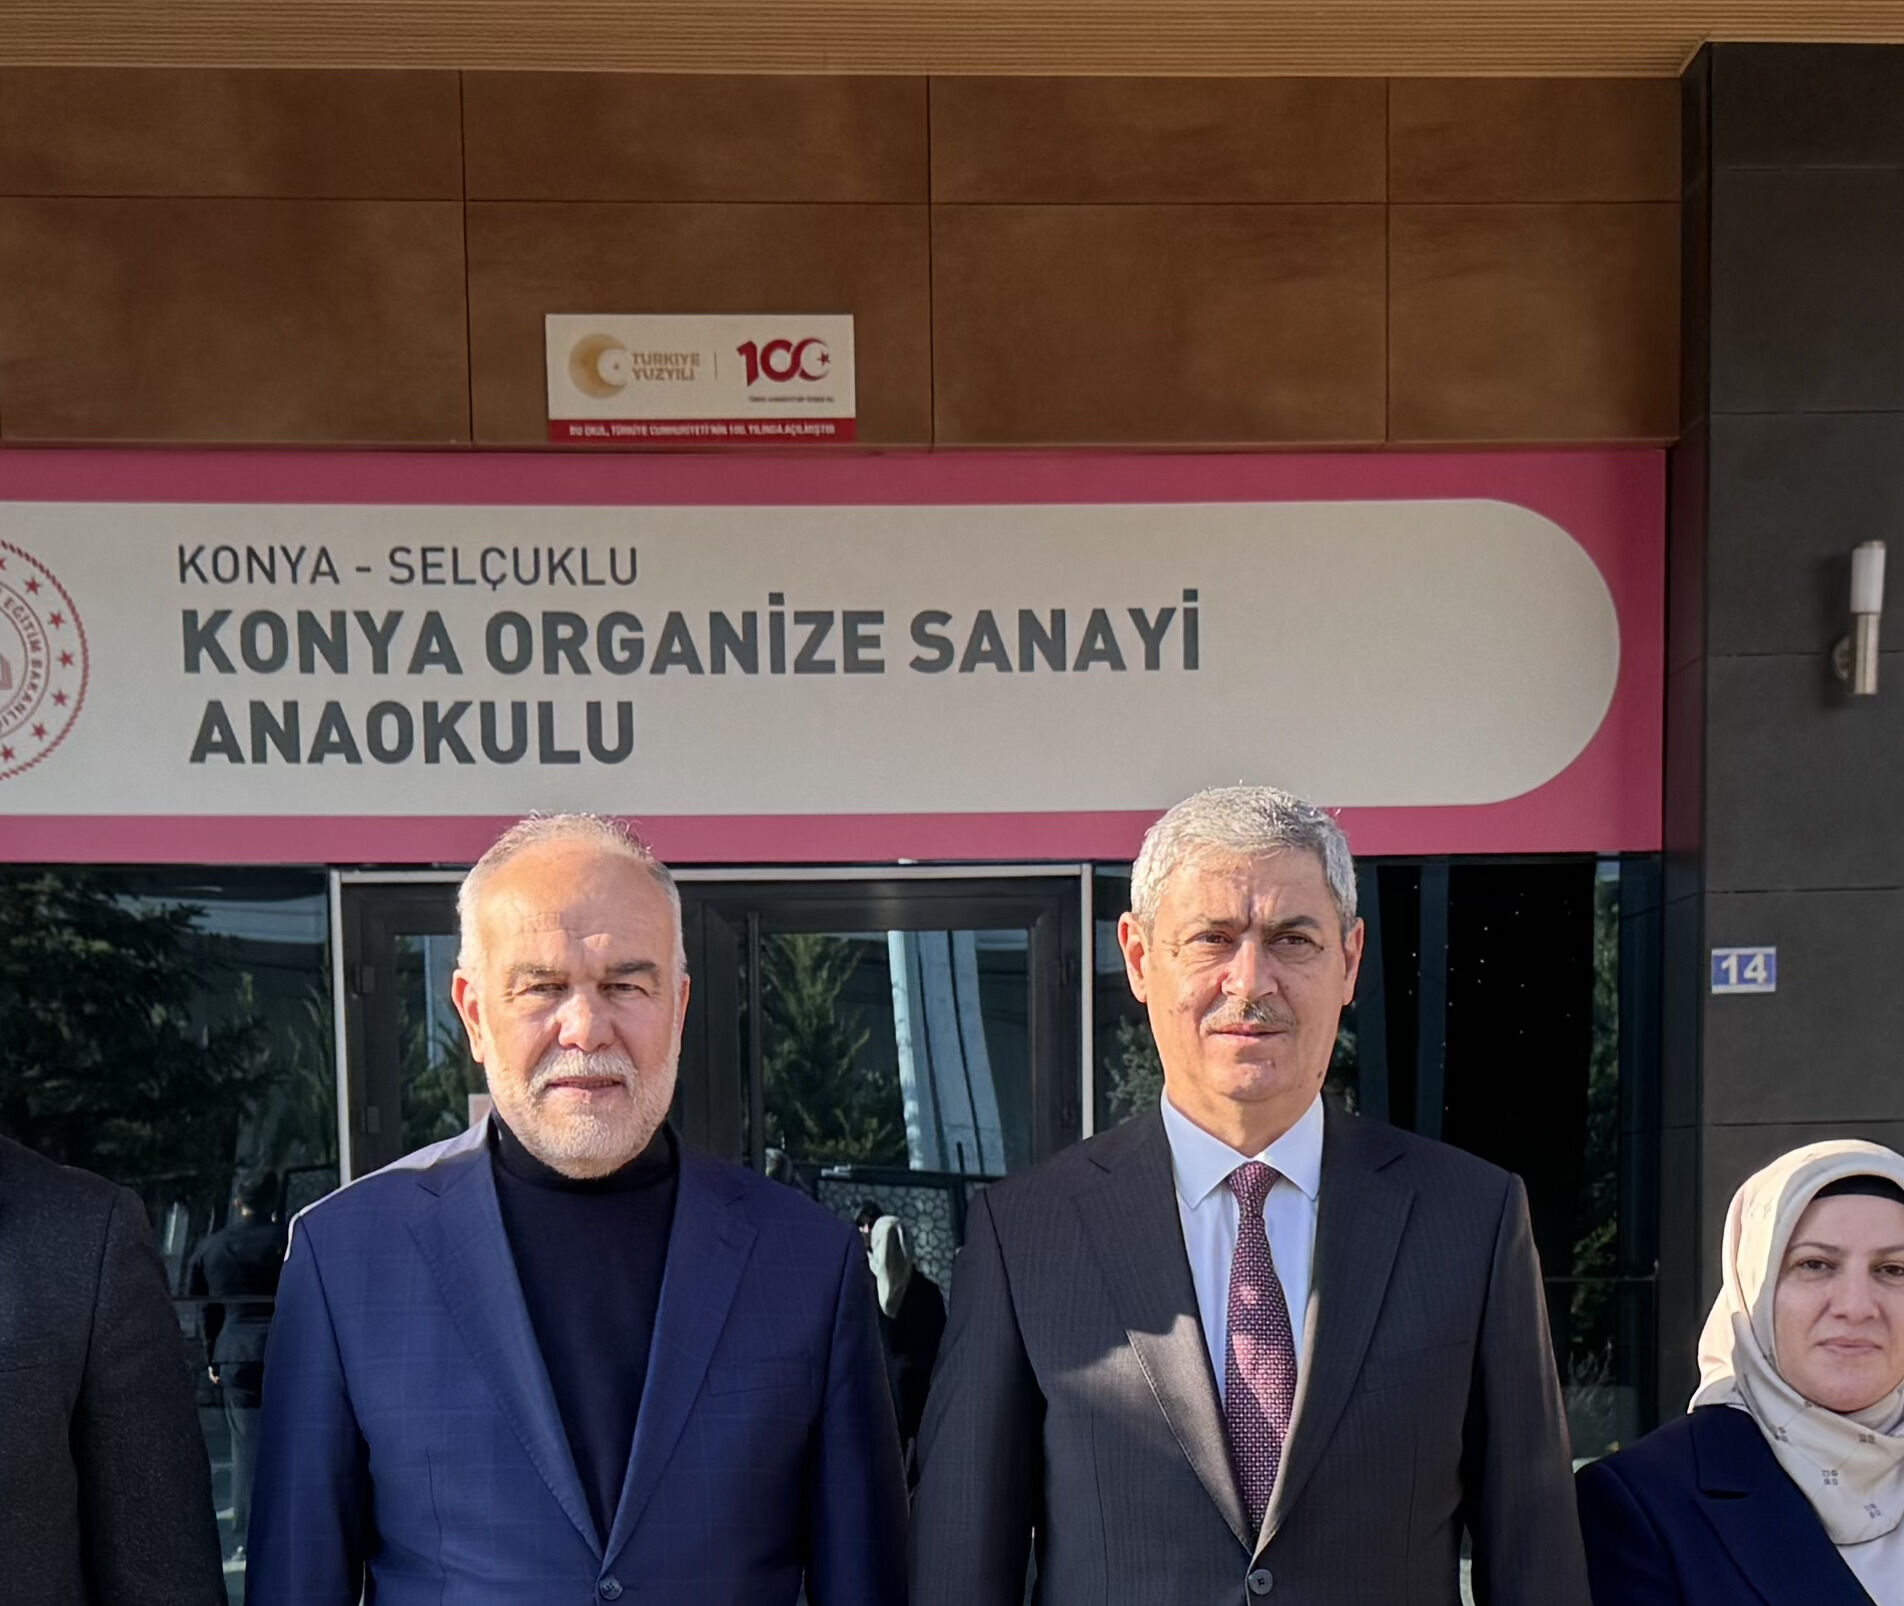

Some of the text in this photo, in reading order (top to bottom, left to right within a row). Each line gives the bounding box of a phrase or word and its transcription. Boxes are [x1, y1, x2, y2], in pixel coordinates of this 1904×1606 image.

[178, 543, 638, 592] KONYA - SELÇUKLU
[182, 588, 1200, 675] KONYA ORGANİZE SANAYİ
[189, 699, 634, 765] ANAOKULU
[1721, 954, 1767, 984] 14
